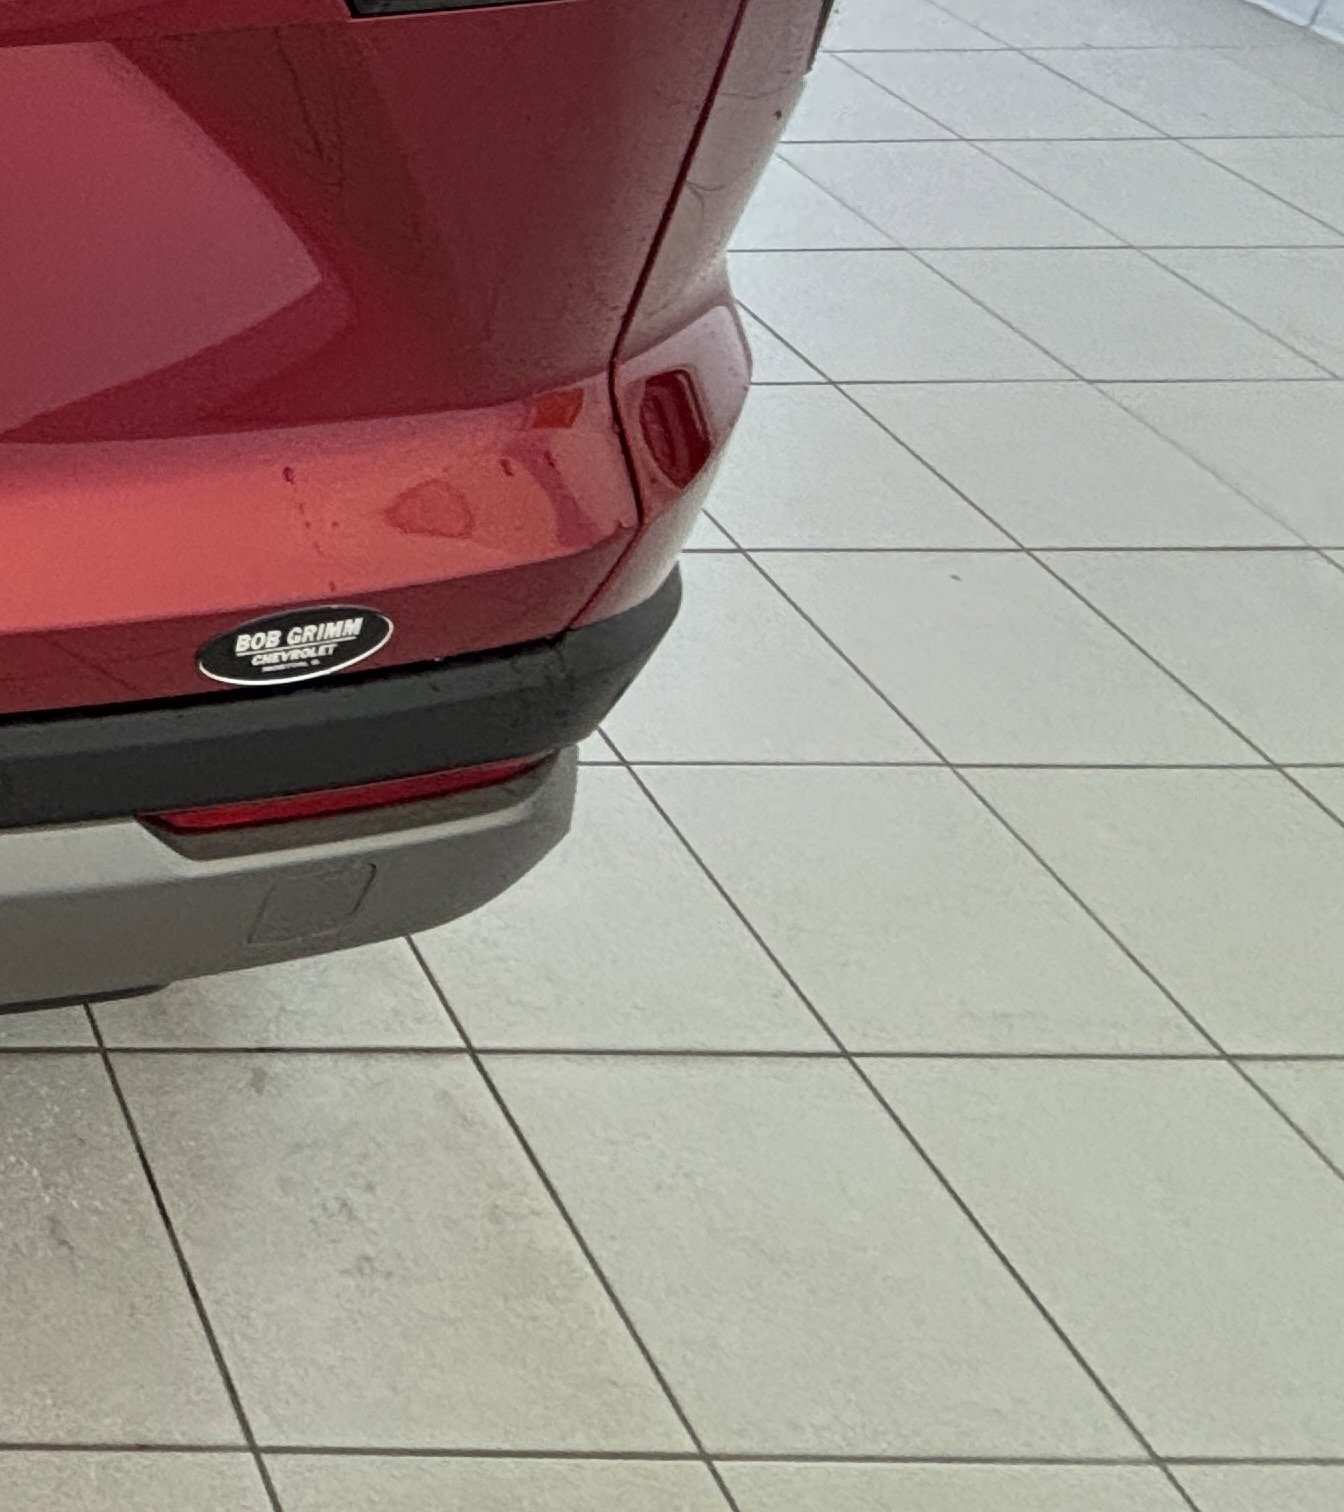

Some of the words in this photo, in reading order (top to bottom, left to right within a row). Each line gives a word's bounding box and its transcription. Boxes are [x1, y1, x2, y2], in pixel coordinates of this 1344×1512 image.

[235, 630, 282, 652] BOB
[287, 617, 364, 645] GRIMM
[251, 643, 339, 666] CHEVROLET
